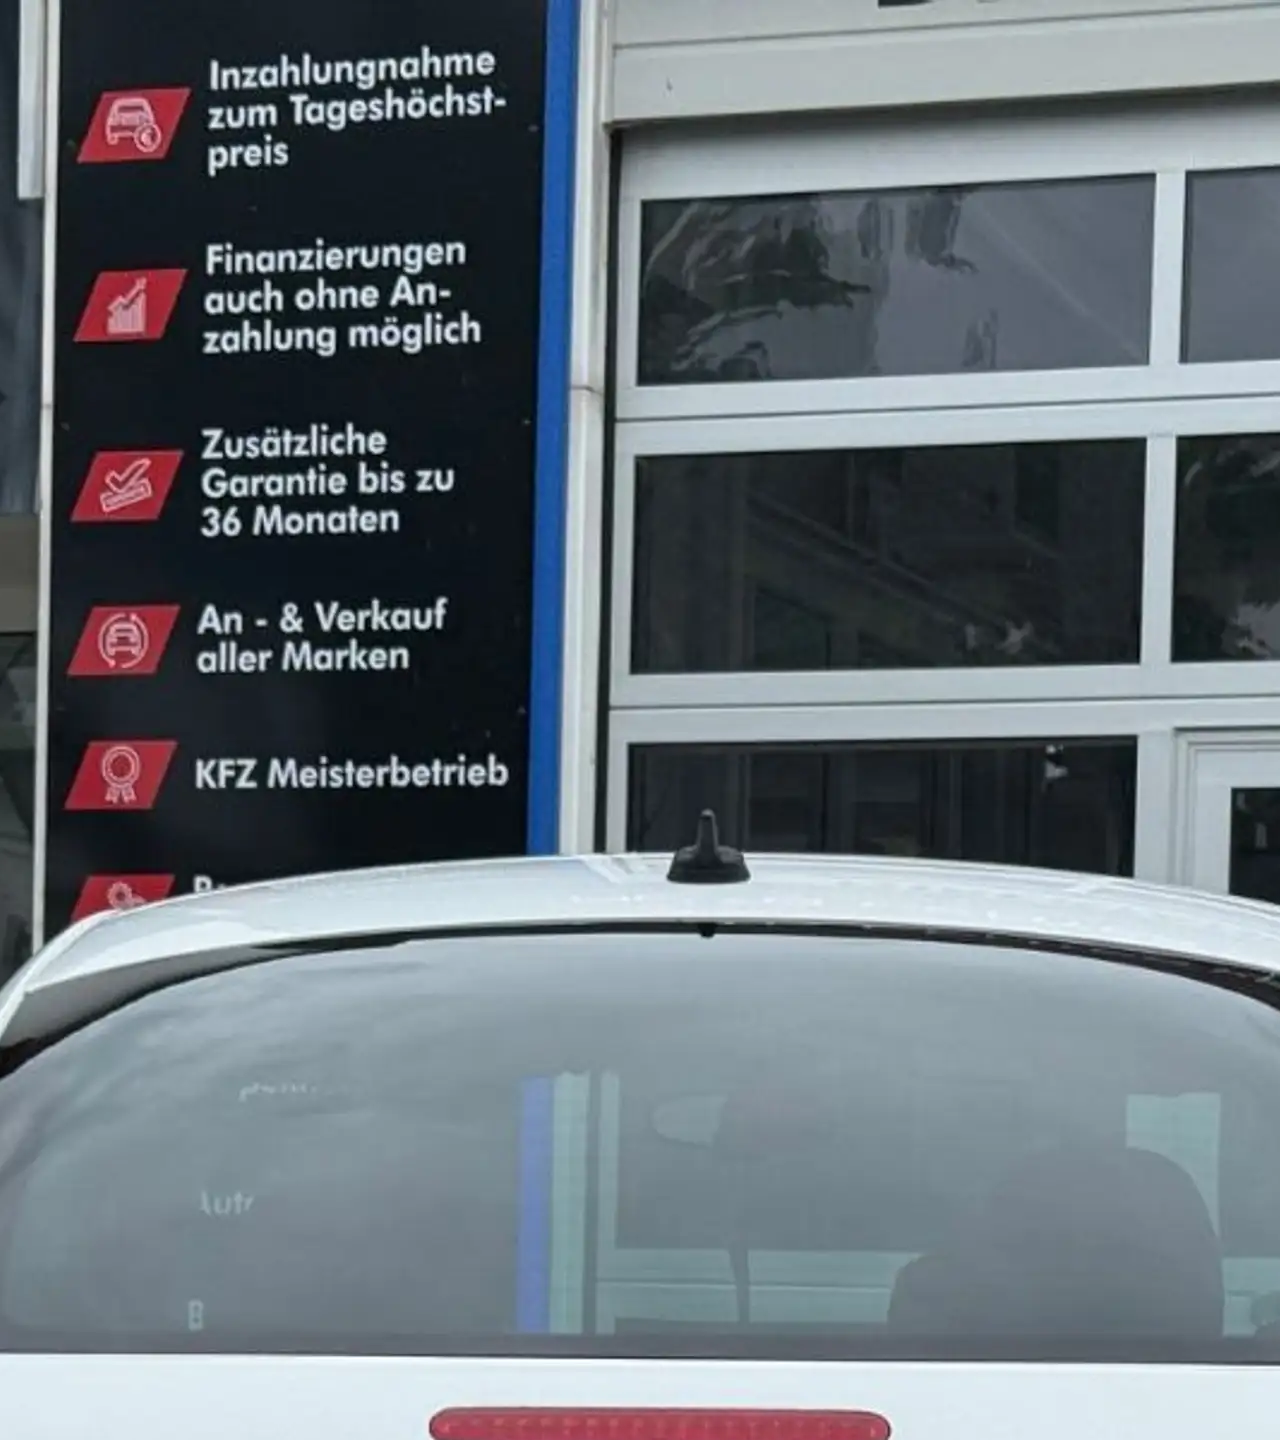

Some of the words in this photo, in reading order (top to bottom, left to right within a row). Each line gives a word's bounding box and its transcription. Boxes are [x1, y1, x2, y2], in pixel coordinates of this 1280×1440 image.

[210, 46, 496, 92] Inzahlungnahme
[208, 103, 277, 129] zum
[289, 86, 507, 129] Tageshöchst-
[208, 135, 290, 177] preis
[206, 237, 467, 281] Finanzierungen
[203, 281, 284, 315] auch
[295, 278, 380, 312] ohne
[390, 276, 452, 308] An-
[202, 319, 336, 357] zahlung
[348, 314, 482, 356] möglich
[202, 422, 388, 460] Zusätzliche
[201, 463, 347, 497] Garantie
[358, 461, 406, 495] bis
[415, 468, 455, 493] zu
[201, 506, 242, 538] 36
[252, 504, 400, 537] Monaten
[278, 602, 304, 634] &
[314, 595, 449, 634] Verkauf
[196, 642, 273, 674] aller
[282, 642, 410, 672] Marken
[195, 758, 258, 790] KFZ
[266, 753, 510, 790] Meisterbetrieb
